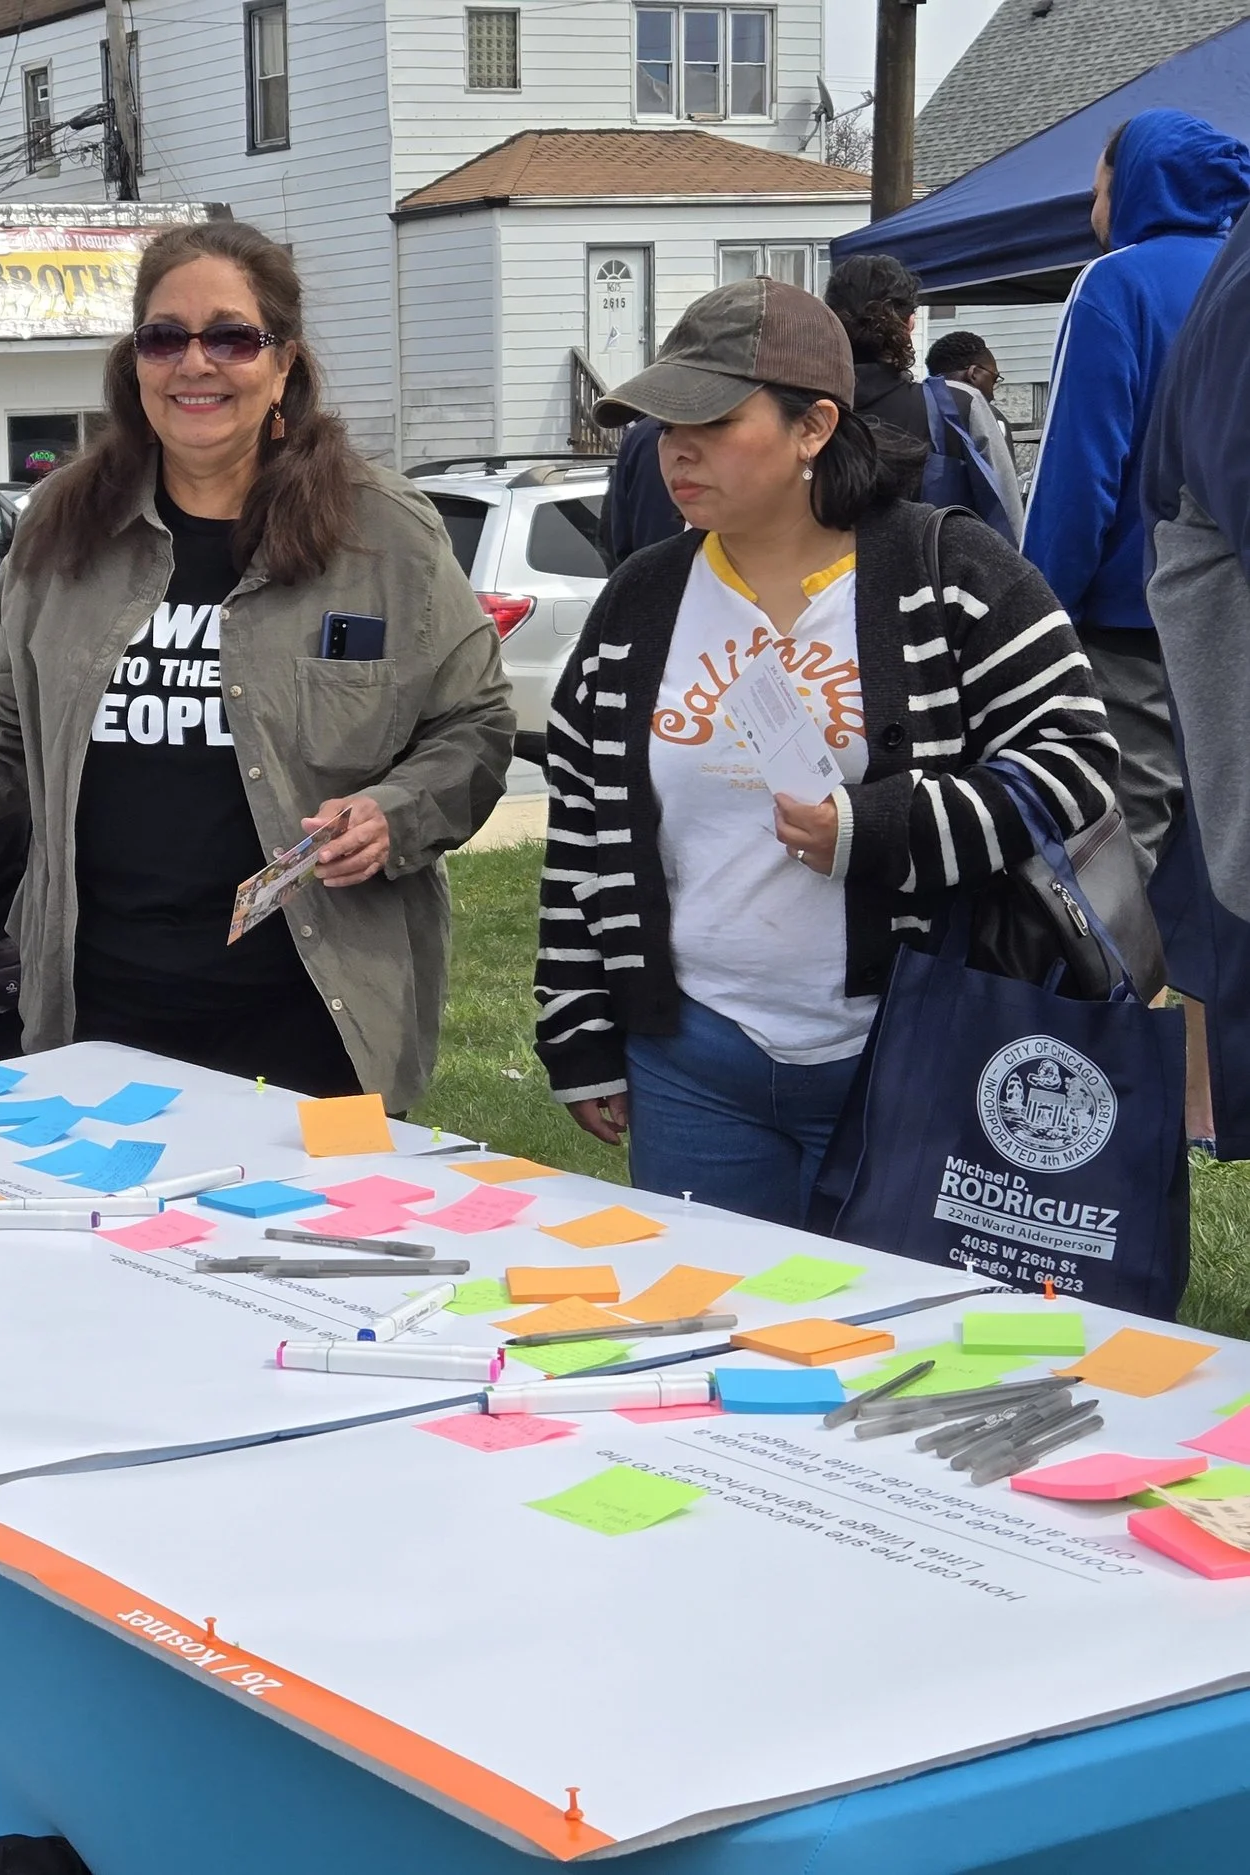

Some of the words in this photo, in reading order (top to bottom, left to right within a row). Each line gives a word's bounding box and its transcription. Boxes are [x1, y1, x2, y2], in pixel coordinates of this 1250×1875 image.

[112, 656, 150, 686] TO
[159, 658, 222, 688] THE
[91, 692, 235, 747] EOPL
[1003, 1042, 1030, 1065] CITY
[1034, 1041, 1049, 1054] OF
[1051, 1044, 1099, 1087] CHICAGO
[983, 1076, 1037, 1164] INCORPORATED
[1040, 1155, 1060, 1167] 4th
[1063, 1128, 1104, 1164] MARCH
[1098, 1098, 1111, 1125] 1837
[945, 1155, 1010, 1187] Michael
[1012, 1175, 1029, 1192] D.
[940, 1169, 1120, 1234] RODRIGUEZ
[947, 1206, 980, 1225] 22nd
[980, 1216, 1016, 1235] Ward
[1017, 1228, 1103, 1254] Alderperson
[949, 1247, 1013, 1278] Chicago,
[1016, 1265, 1031, 1281] IL
[960, 1234, 998, 1256] 4035
[1001, 1245, 1018, 1261] W
[1020, 1250, 1056, 1271] 26th
[1059, 1259, 1078, 1275] St
[166, 1275, 191, 1286] me
[188, 1284, 206, 1294] to
[206, 1289, 257, 1309] special
[323, 1296, 346, 1305] es
[253, 1307, 270, 1316] is
[268, 1312, 318, 1333] Village
[596, 1449, 633, 1464] the
[709, 1433, 823, 1474] bienvenida
[737, 1431, 821, 1460] Village?
[631, 1462, 652, 1472] to
[822, 1471, 846, 1482] la
[824, 1458, 882, 1479] Little
[673, 1463, 841, 1521] neighborhood?
[843, 1480, 886, 1495] dar
[881, 1476, 913, 1488] de
[724, 1495, 823, 1532] welcome
[887, 1493, 939, 1511] sitio
[914, 1487, 1036, 1529] vecindario
[933, 1509, 964, 1520] el
[824, 1530, 870, 1548] site
[838, 1519, 916, 1550] Village
[965, 1519, 1050, 1546] puede
[1034, 1527, 1067, 1538] al
[870, 1546, 913, 1563] the
[919, 1546, 985, 1571] Little
[1066, 1536, 1136, 1560] otros
[913, 1561, 962, 1579] can
[1046, 1544, 1144, 1577] ¿Cómo
[961, 1578, 1028, 1602] How
[116, 1608, 227, 1668] Kostner
[209, 1663, 250, 1674] /
[230, 1671, 284, 1696] 26
